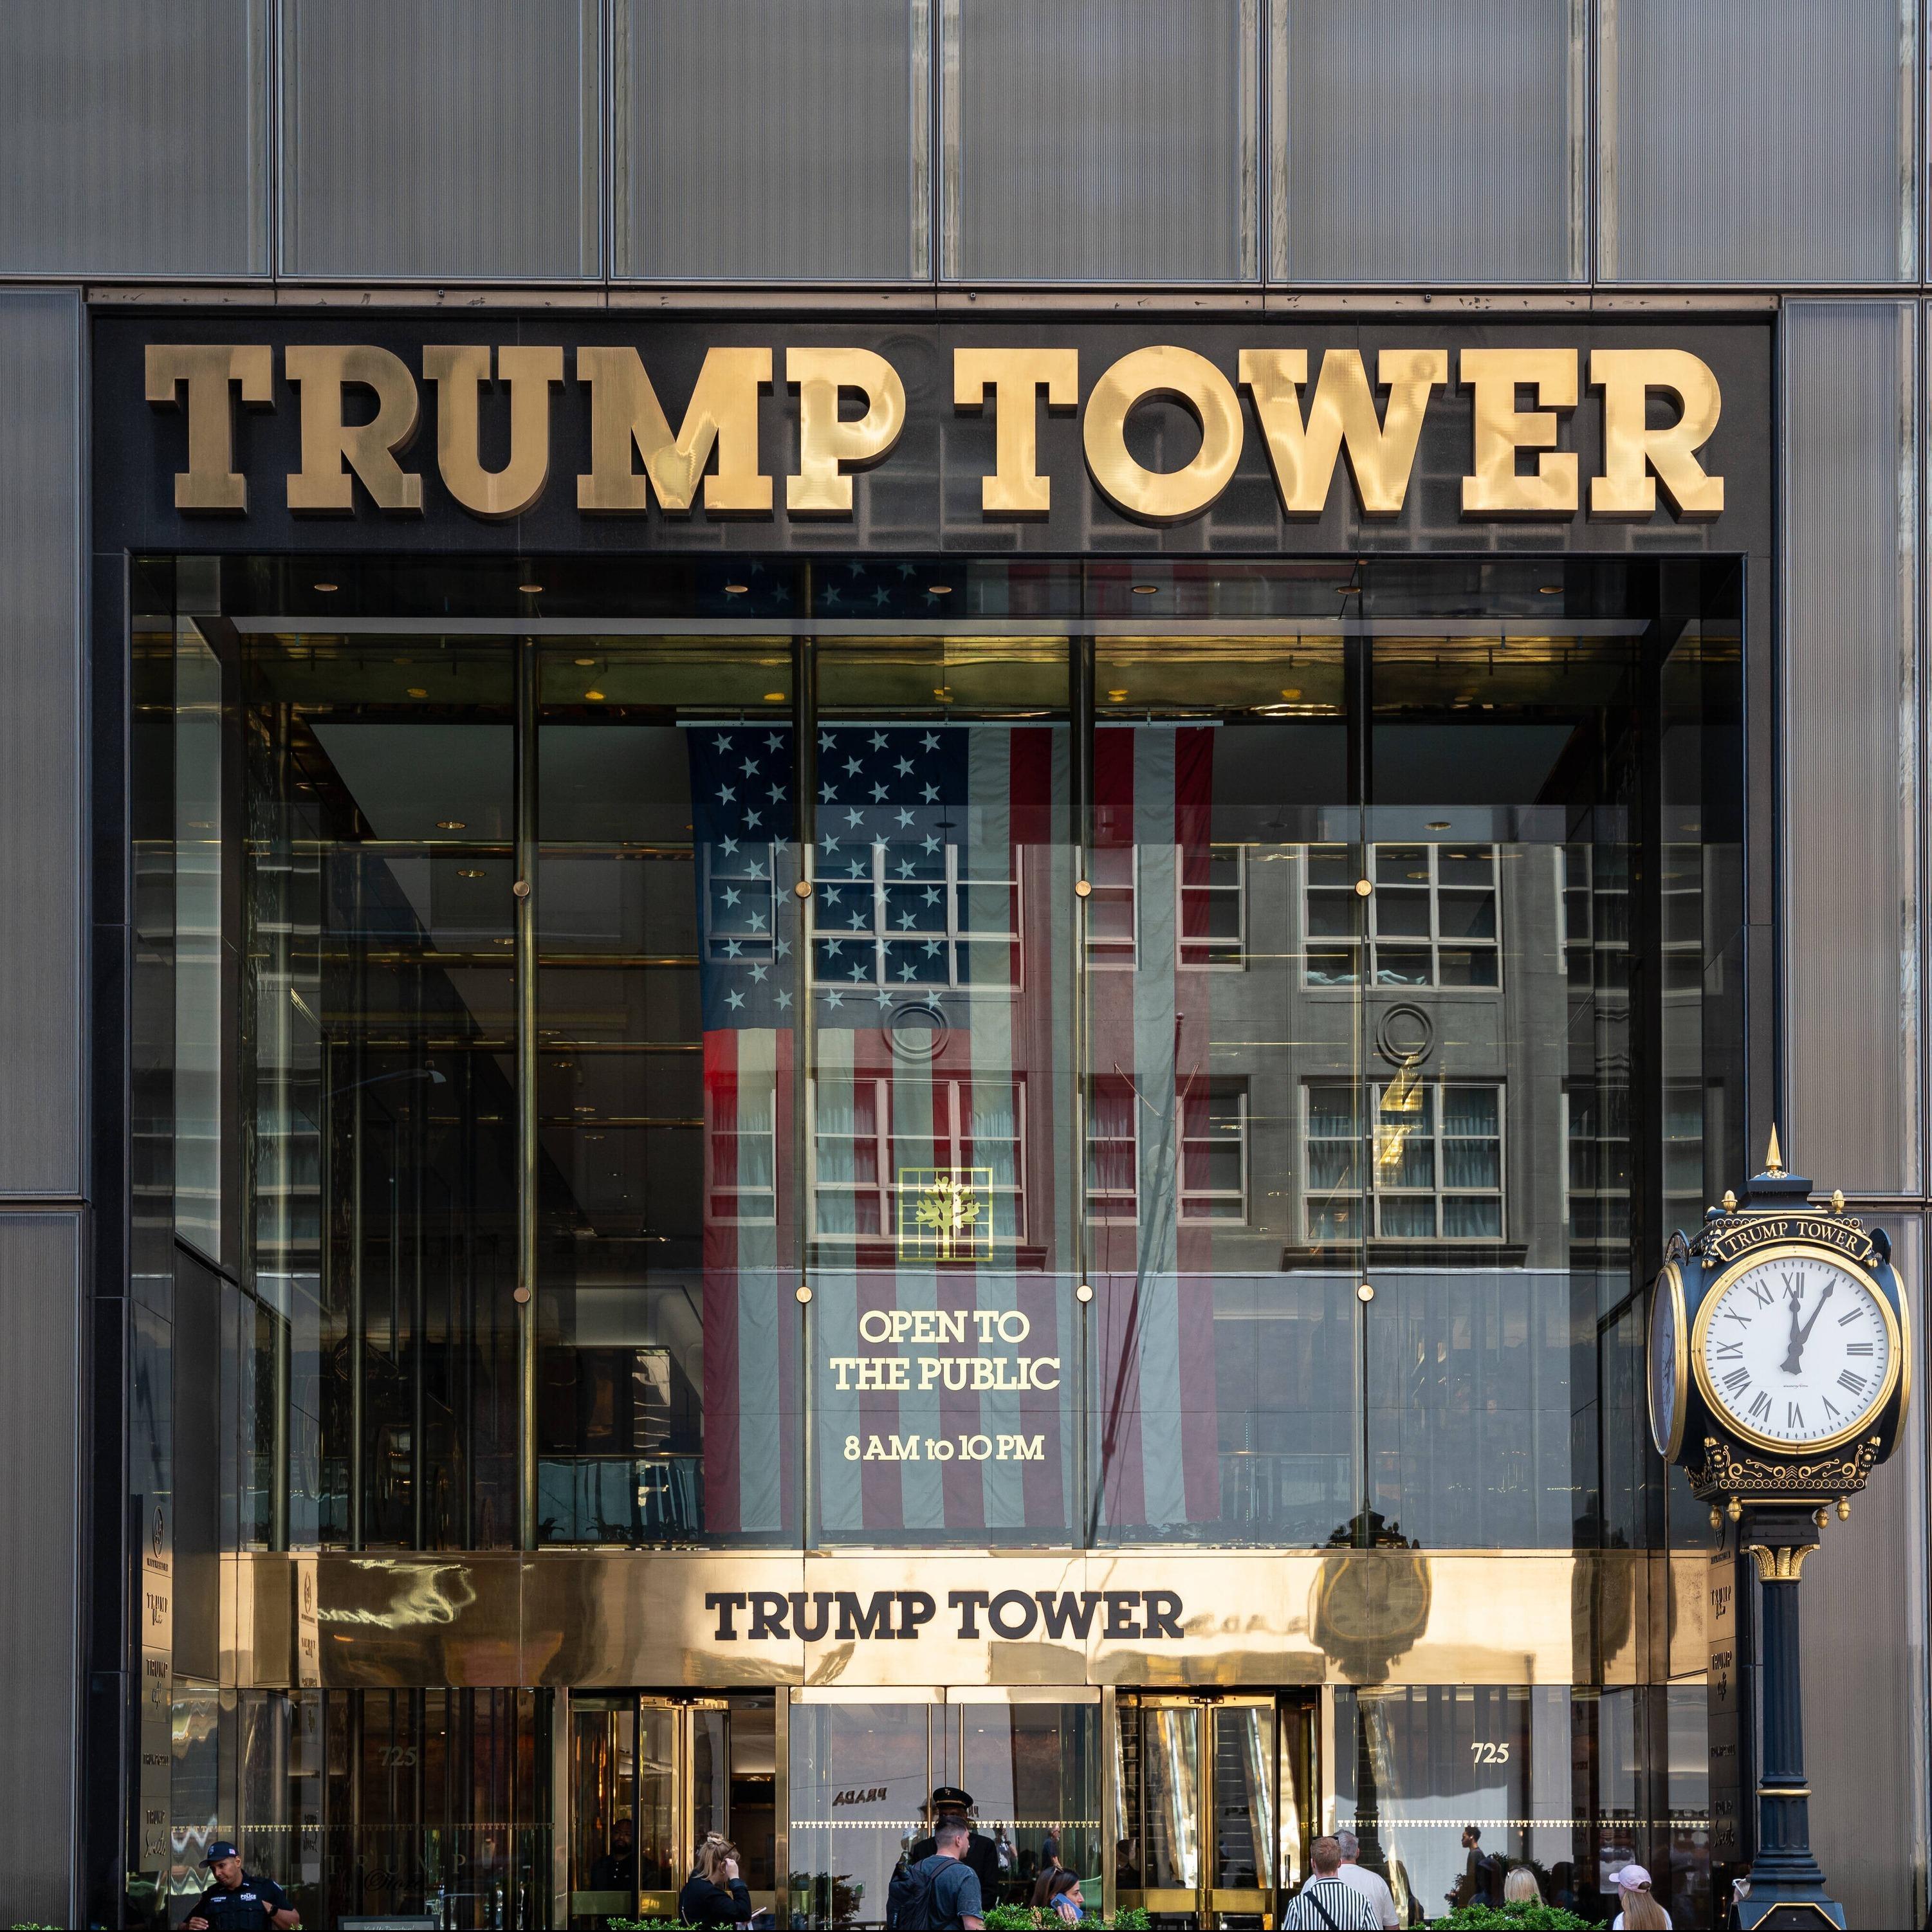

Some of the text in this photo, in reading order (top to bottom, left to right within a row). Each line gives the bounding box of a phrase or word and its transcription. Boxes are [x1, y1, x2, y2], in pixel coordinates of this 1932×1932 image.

[145, 344, 1725, 521] TRUMP TOWER
[1725, 1221, 1858, 1253] TRUMP TOWER
[1781, 1272, 1805, 1299] XII
[859, 1310, 1030, 1343] OPEN TO
[829, 1357, 1061, 1391] THE PUBLIC
[843, 1435, 1045, 1461] 8 AM to 10 PM
[1710, 1585, 1731, 1606] TRUMP
[705, 1590, 936, 1642] TRUMP
[948, 1589, 1184, 1640] TOWER
[147, 1659, 168, 1678] TRUMP
[1711, 1651, 1732, 1670] TRUMP
[378, 1745, 418, 1767] 725
[1470, 1742, 1509, 1763] 725
[147, 1810, 165, 1825] TRUMP
